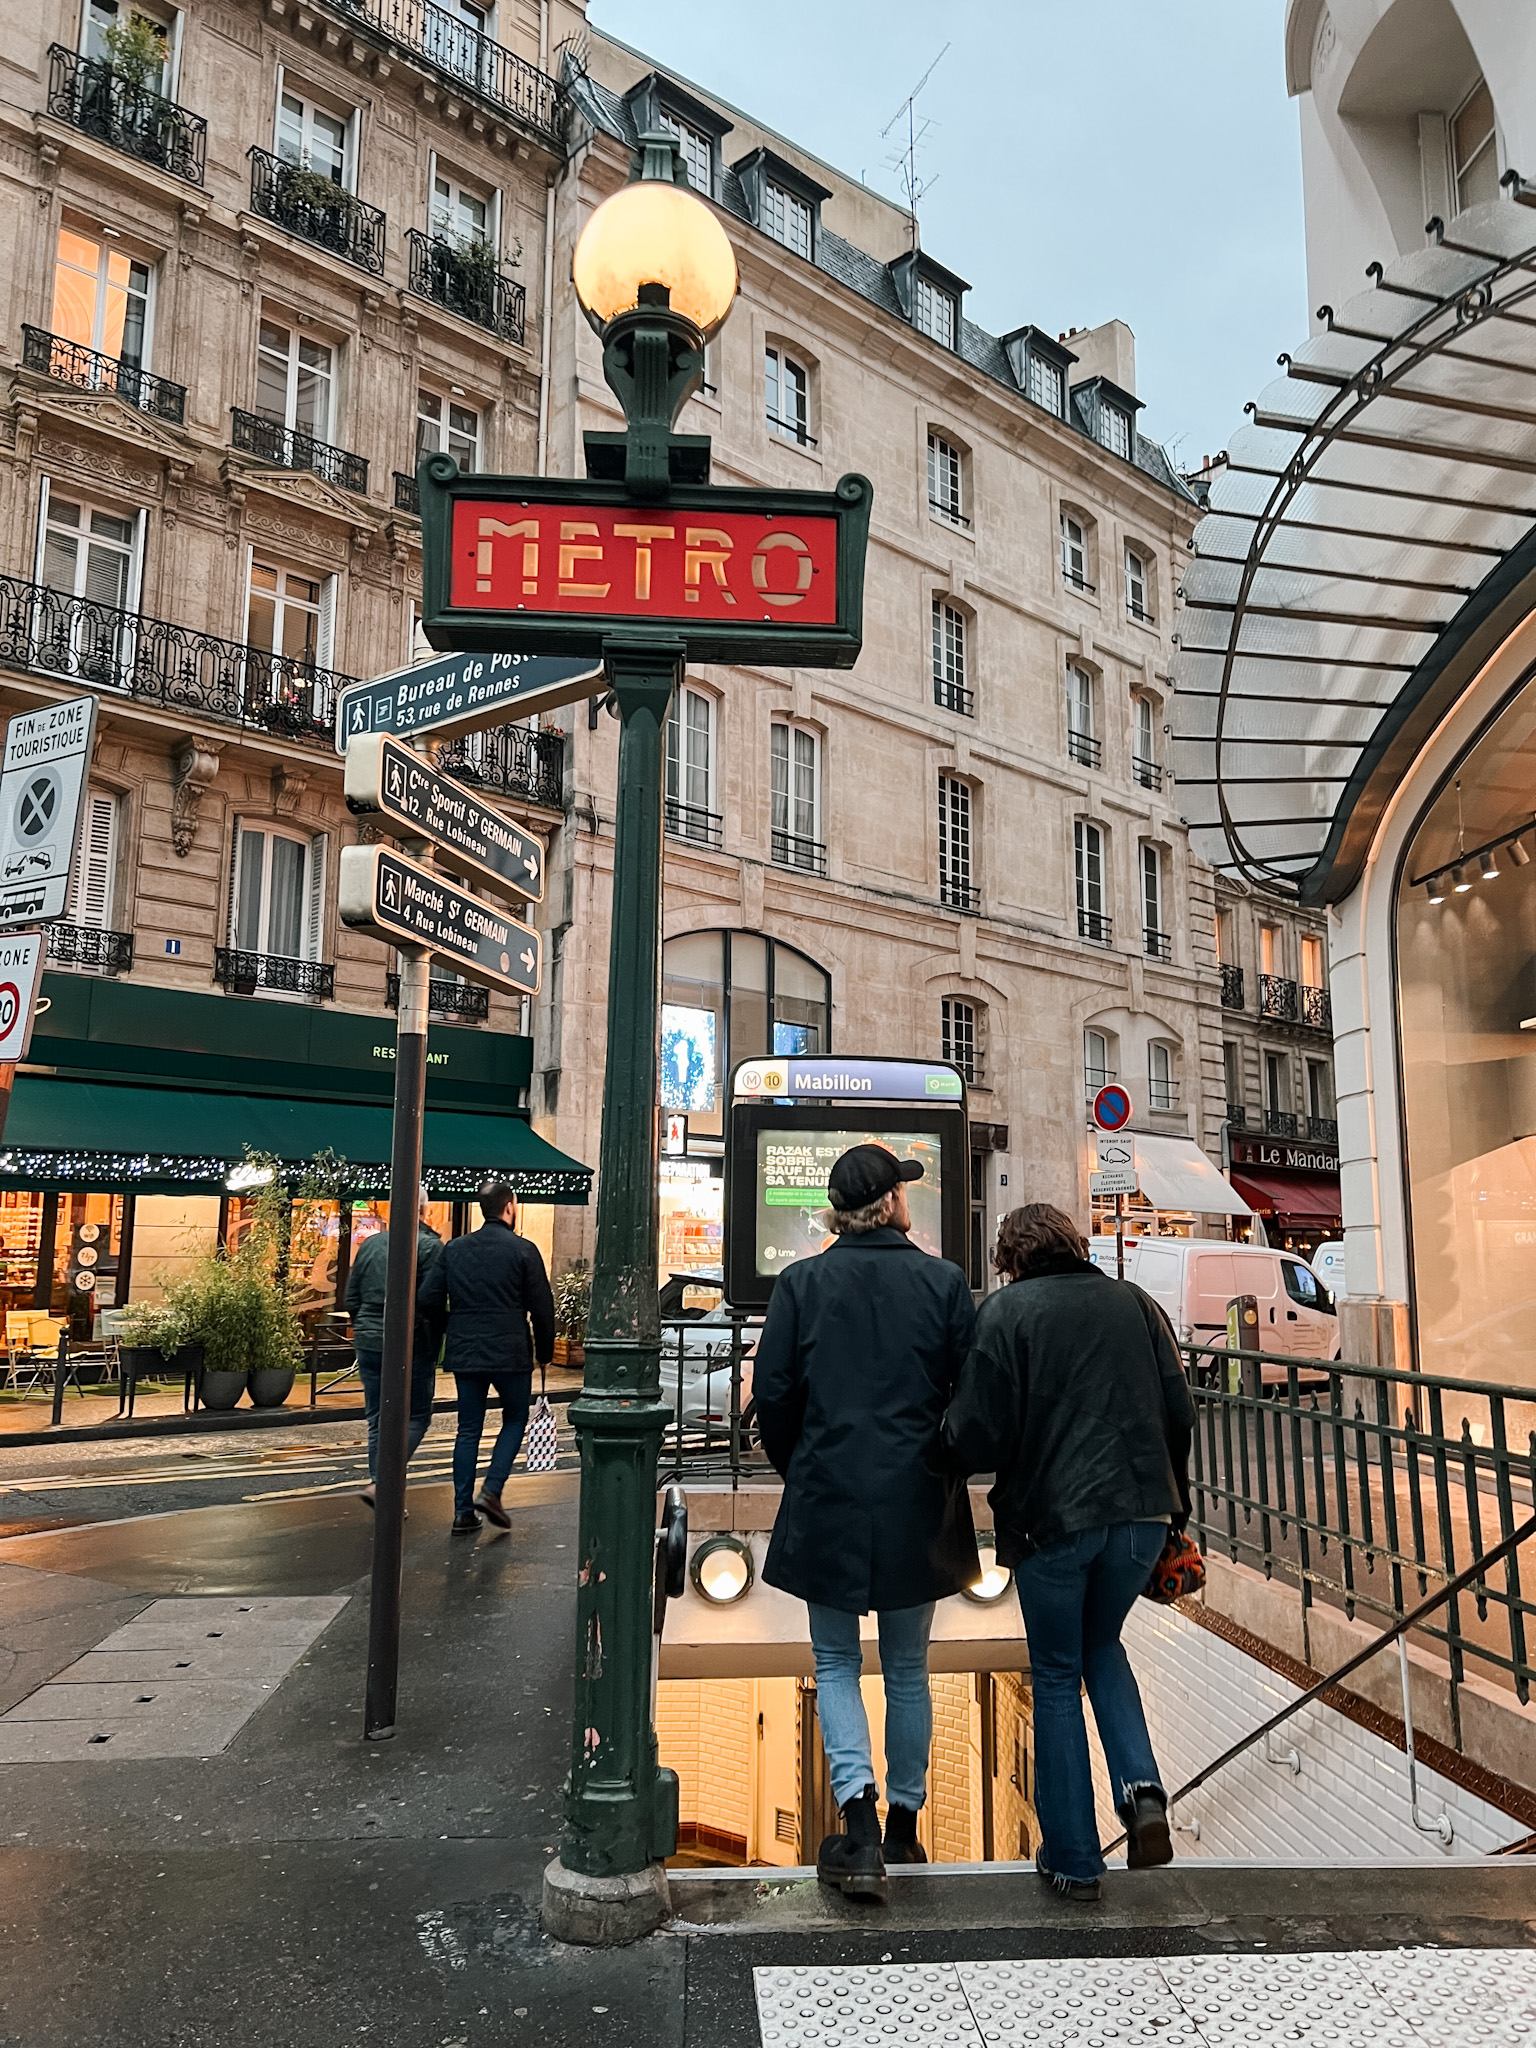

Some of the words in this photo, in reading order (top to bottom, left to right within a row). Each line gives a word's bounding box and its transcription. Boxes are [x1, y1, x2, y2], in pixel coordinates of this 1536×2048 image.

[476, 517, 813, 606] METRO
[397, 672, 456, 706] Bureau
[463, 660, 483, 683] de
[490, 652, 538, 673] Pos
[396, 707, 416, 728] 53,
[418, 702, 441, 720] rue
[446, 693, 462, 711] de
[468, 674, 520, 704] Rennes
[15, 719, 36, 738] FIN
[38, 723, 46, 732] DE
[49, 705, 84, 729] ZONE
[11, 727, 84, 761] TOURISTIQUE
[408, 796, 423, 818] 12,
[426, 807, 444, 832] Rue
[447, 820, 487, 858] Lobineau
[409, 769, 430, 790] Ctre
[431, 784, 467, 821] Sportif
[480, 817, 523, 858] GERMAIN
[404, 875, 444, 914] Marché
[464, 908, 508, 946] GERMAIN
[403, 905, 415, 924] 4,
[415, 910, 435, 932] Rue
[436, 920, 478, 954] Lobineau
[0, 948, 31, 966] ONE
[0, 999, 13, 1025] 0
[373, 1046, 450, 1066] RESANT
[766, 1075, 780, 1087] 10
[795, 1073, 872, 1091] Mabillon
[766, 1145, 812, 1156] RAZAK
[815, 1147, 842, 1157] EST
[766, 1156, 818, 1167] SOBRE.
[1260, 1145, 1280, 1165] Le
[1285, 1148, 1340, 1171] Mandar
[765, 1166, 803, 1176] SAUF
[806, 1167, 832, 1176] DAN
[765, 1175, 786, 1186] SA
